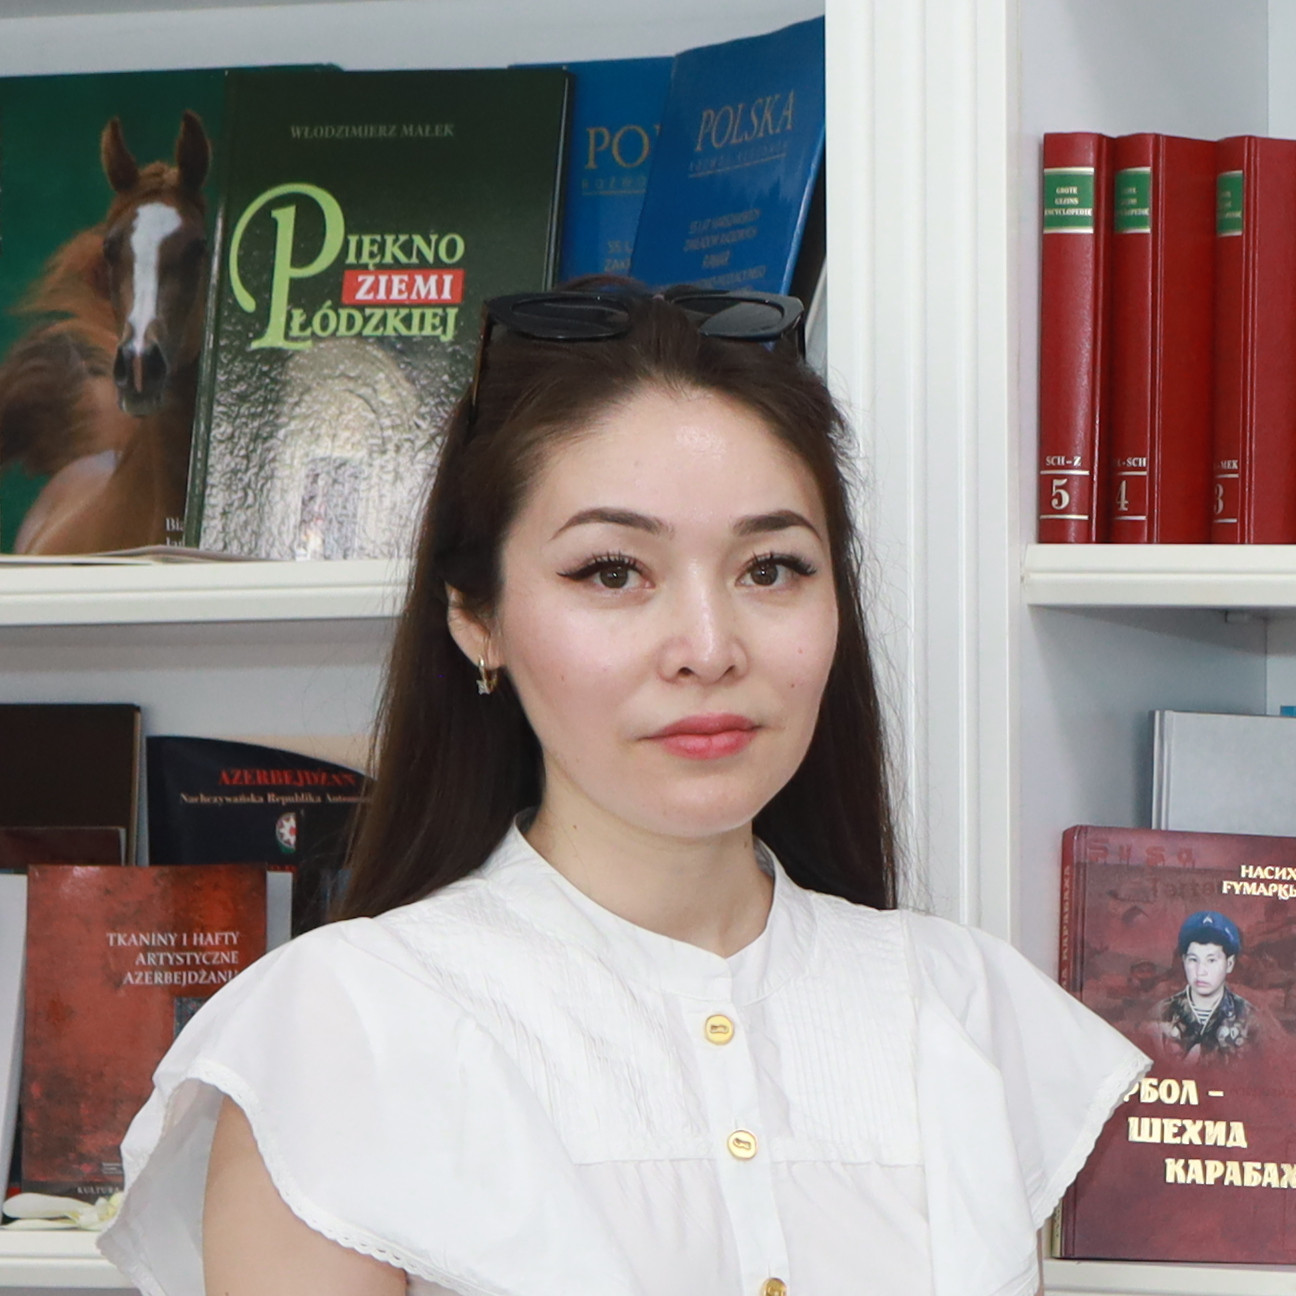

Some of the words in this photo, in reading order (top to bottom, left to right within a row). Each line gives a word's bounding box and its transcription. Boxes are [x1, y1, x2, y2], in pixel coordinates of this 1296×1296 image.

[695, 89, 795, 153] POLSKA
[585, 124, 661, 170] PO
[355, 273, 454, 301] ZIEMI
[288, 300, 459, 342] ŁÓDZKIEJ
[1051, 478, 1070, 511] 5
[1114, 480, 1129, 512] 4
[106, 932, 178, 947] TKANINY
[182, 933, 188, 947] I
[192, 931, 240, 946] HAFTY
[135, 950, 240, 967] ARTYSTYCZNE
[1127, 1117, 1248, 1149] ШЕХИД
